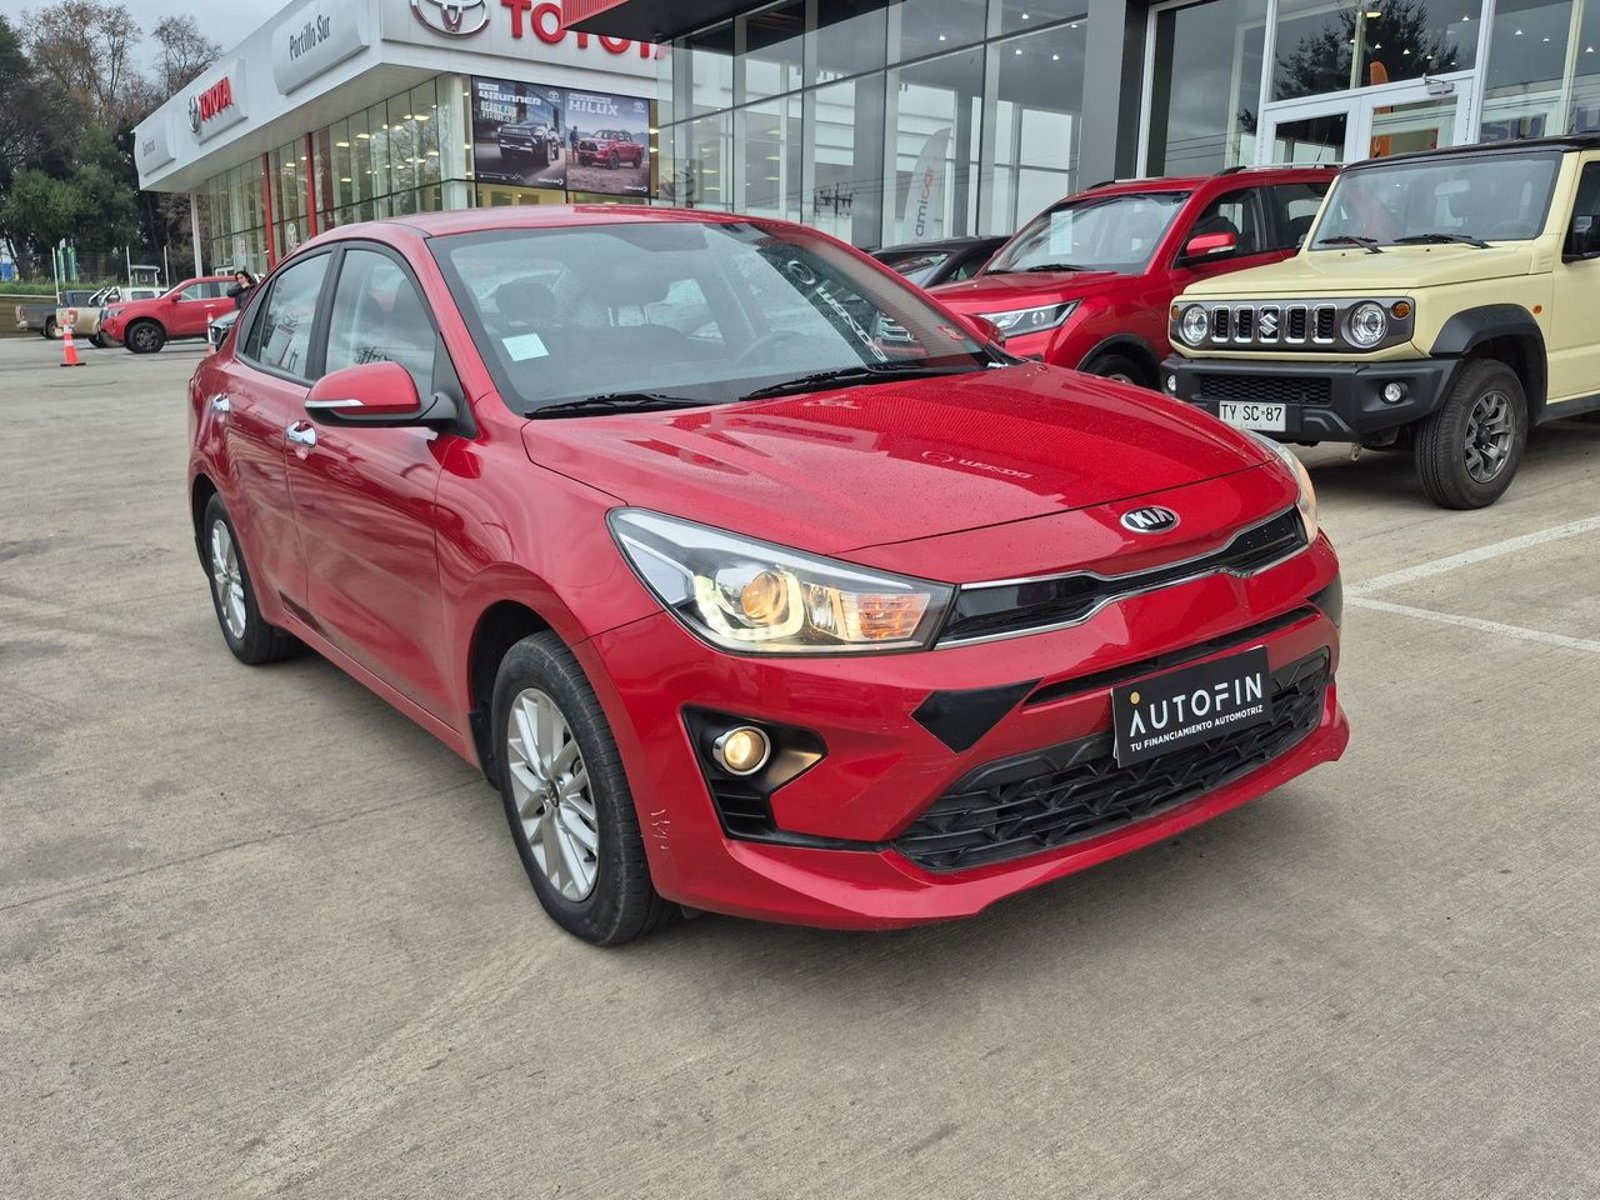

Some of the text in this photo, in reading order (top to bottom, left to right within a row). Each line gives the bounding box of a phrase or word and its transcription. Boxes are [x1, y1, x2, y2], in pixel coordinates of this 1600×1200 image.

[289, 14, 331, 61] Portillo Sur
[198, 76, 232, 121] TOYOTA
[568, 99, 619, 116] HILUX
[1127, 508, 1174, 528] KIA
[1129, 672, 1263, 738] AUTOFIN
[1130, 704, 1264, 752] TU FINANCIAMIENTO AUTOMOTRIZ
